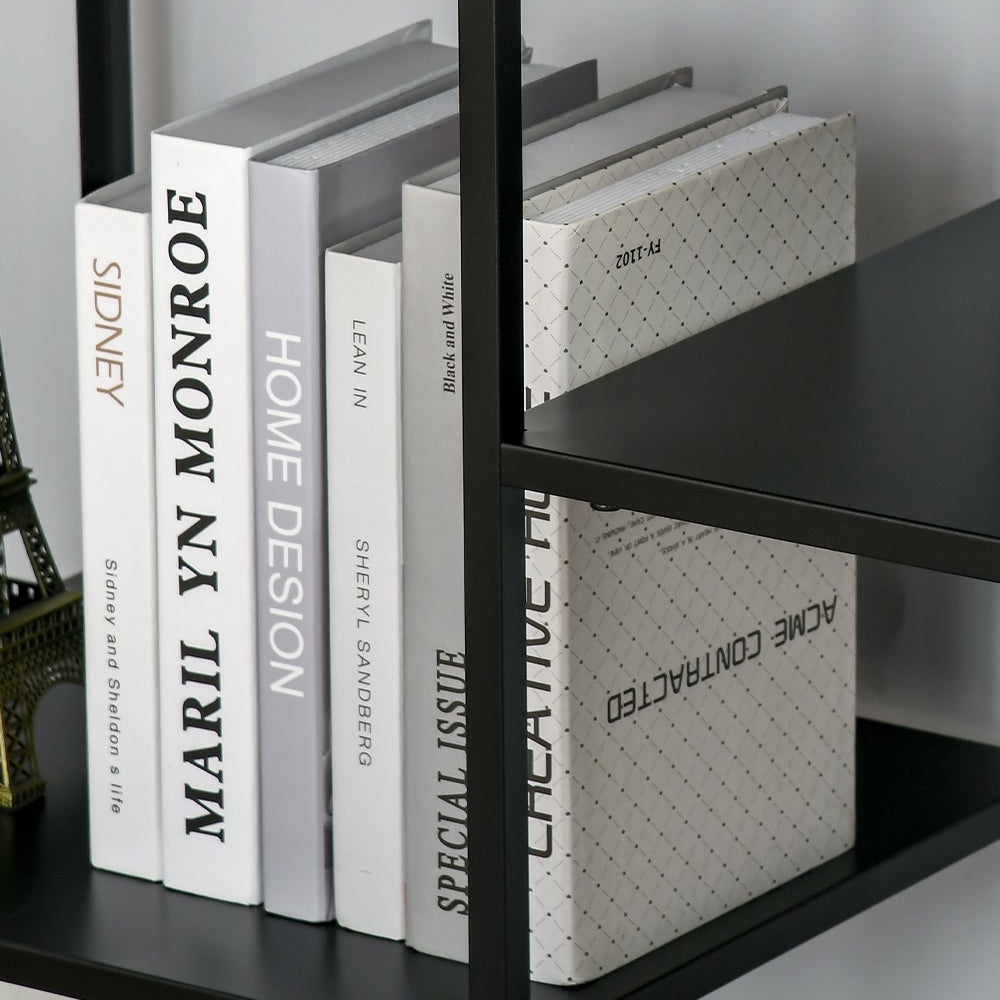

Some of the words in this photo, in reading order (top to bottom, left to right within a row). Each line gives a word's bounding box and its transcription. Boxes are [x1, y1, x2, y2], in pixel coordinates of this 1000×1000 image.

[616, 238, 661, 269] FY-1102
[92, 257, 125, 408] SIDNEY
[442, 272, 454, 316] White
[166, 188, 215, 483] MONROE
[352, 319, 367, 375] LEAN
[443, 320, 455, 348] and
[443, 352, 456, 394] Black
[265, 330, 302, 487] HOME
[353, 387, 367, 409] IN
[176, 505, 218, 597] YN
[356, 539, 371, 629] SHERYL
[105, 559, 118, 625] Sidney
[774, 595, 837, 648] ACME
[107, 633, 118, 669] and
[607, 630, 761, 724] CONTRACTED
[108, 678, 122, 756] Sheldon
[180, 629, 225, 843] MARIL
[357, 640, 372, 767] SANDBERG
[436, 648, 467, 752] ISSUE
[110, 779, 122, 814] life
[436, 766, 468, 917] SPECIAL
